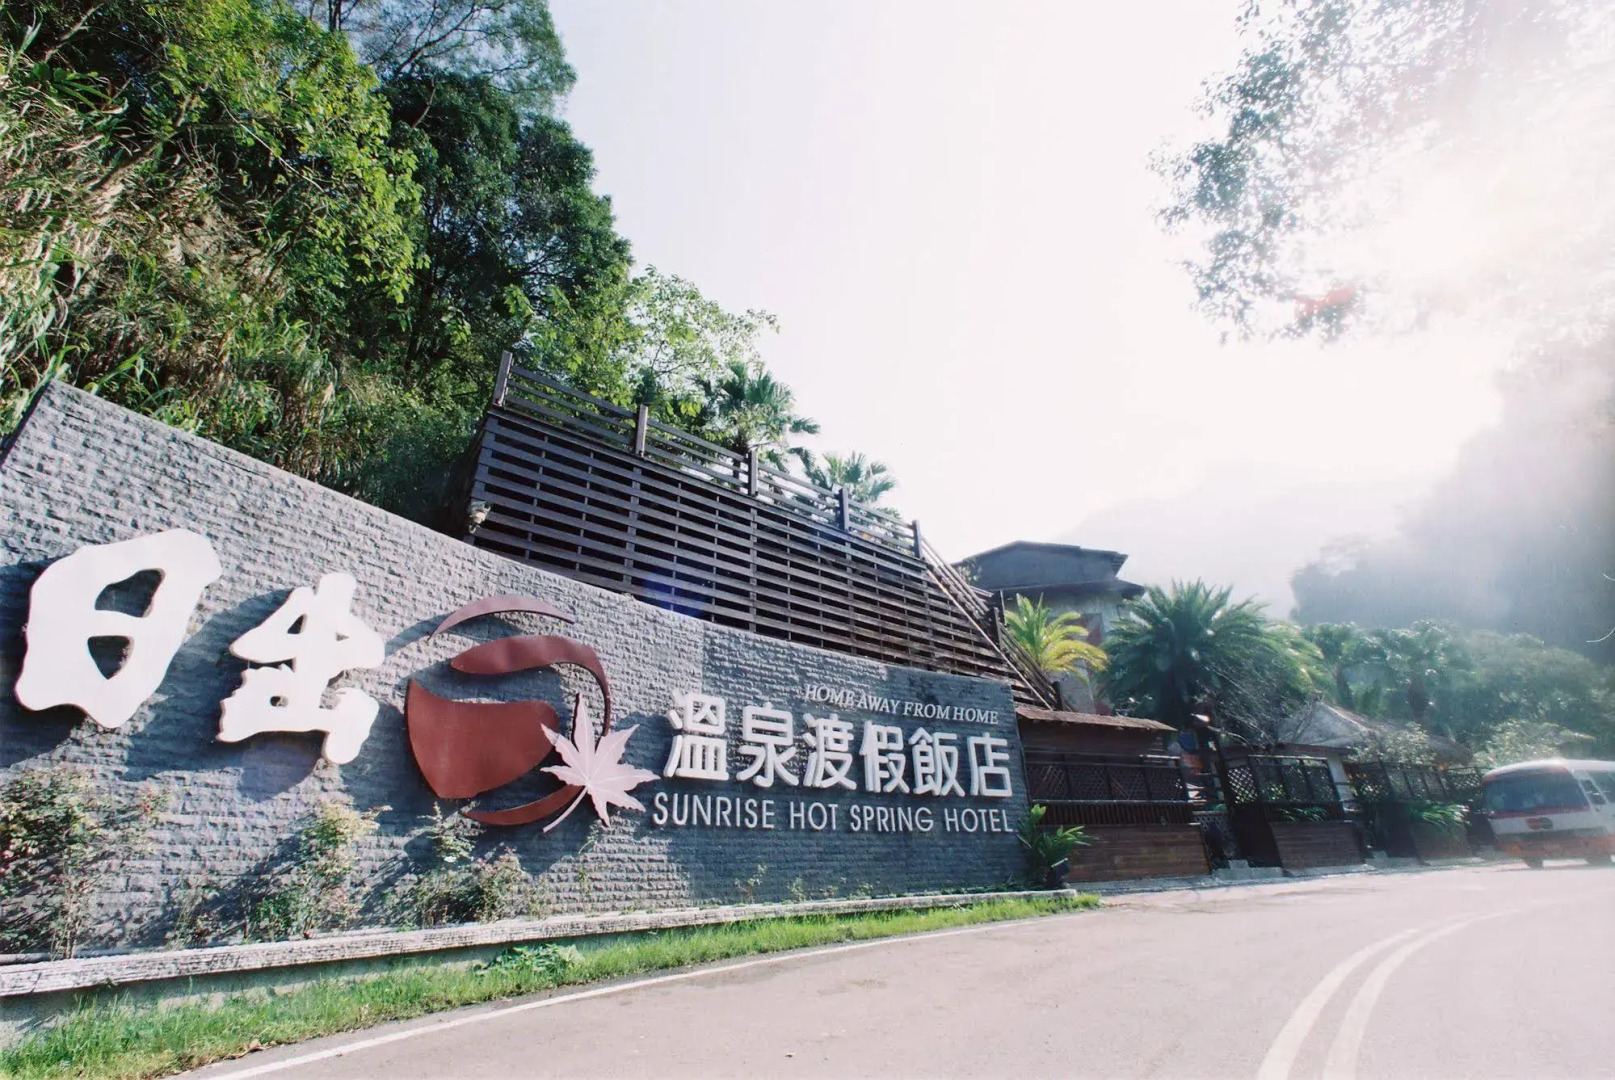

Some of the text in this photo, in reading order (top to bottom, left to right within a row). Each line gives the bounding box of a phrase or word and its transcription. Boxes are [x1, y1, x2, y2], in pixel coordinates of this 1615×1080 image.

[803, 684, 999, 725] HOME AWAY FROM HOME
[664, 689, 1013, 797] 溫泉渡假飯店
[652, 791, 1014, 833] SUNRISE HOT SPRING HOTEL
